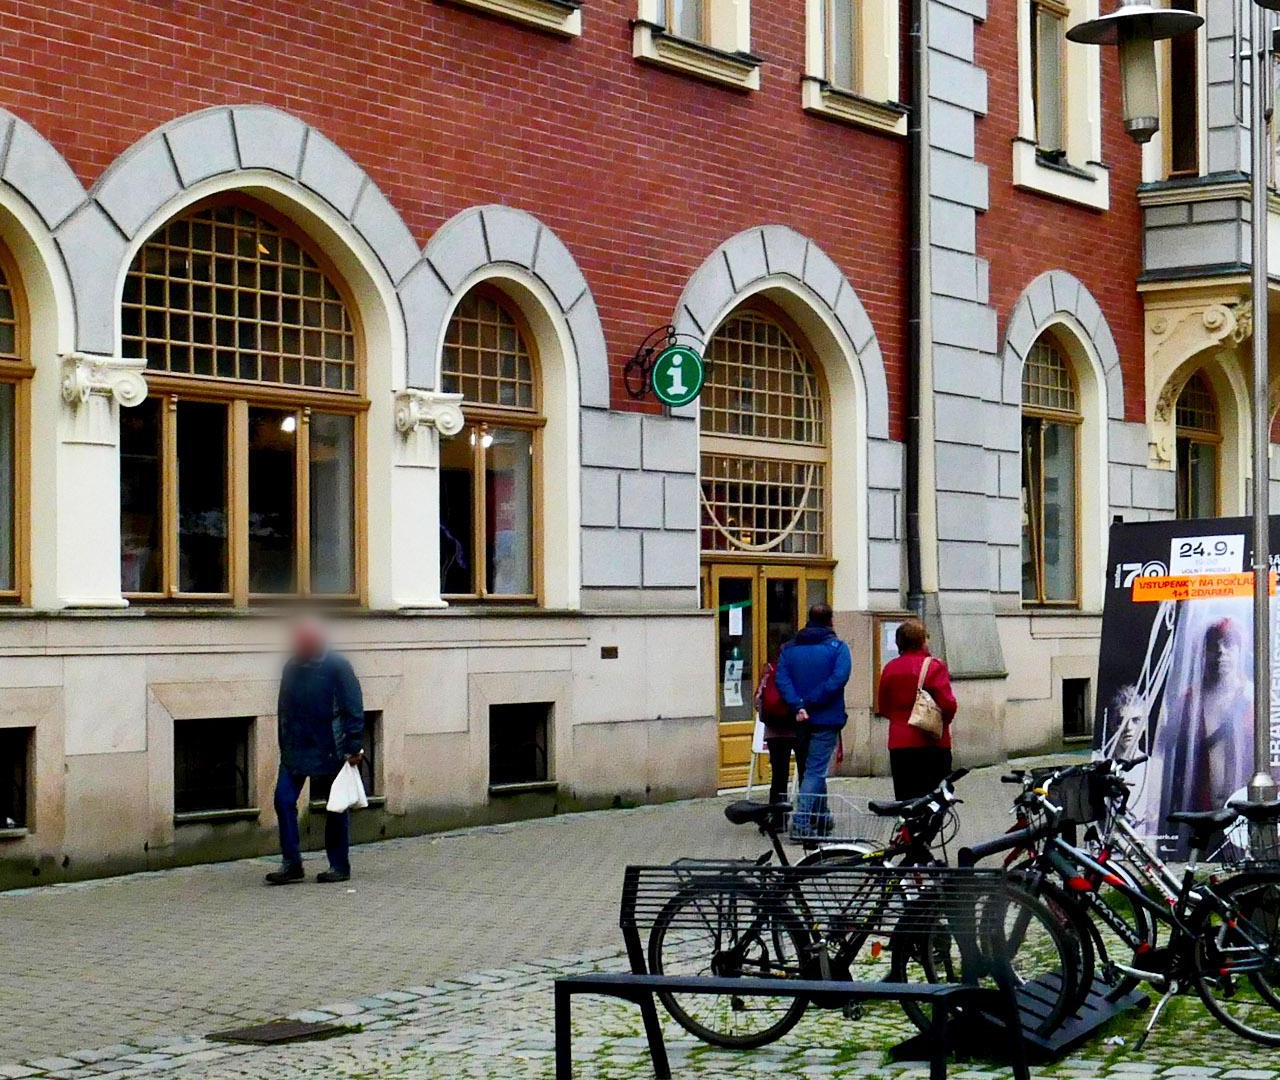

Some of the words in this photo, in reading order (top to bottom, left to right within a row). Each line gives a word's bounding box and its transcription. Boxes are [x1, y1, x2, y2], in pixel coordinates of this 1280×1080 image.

[1179, 540, 1235, 558] 24.9.
[1139, 580, 1195, 590] VSTUPENKY
[1199, 578, 1213, 587] NA
[1191, 588, 1234, 597] ZDARMA
